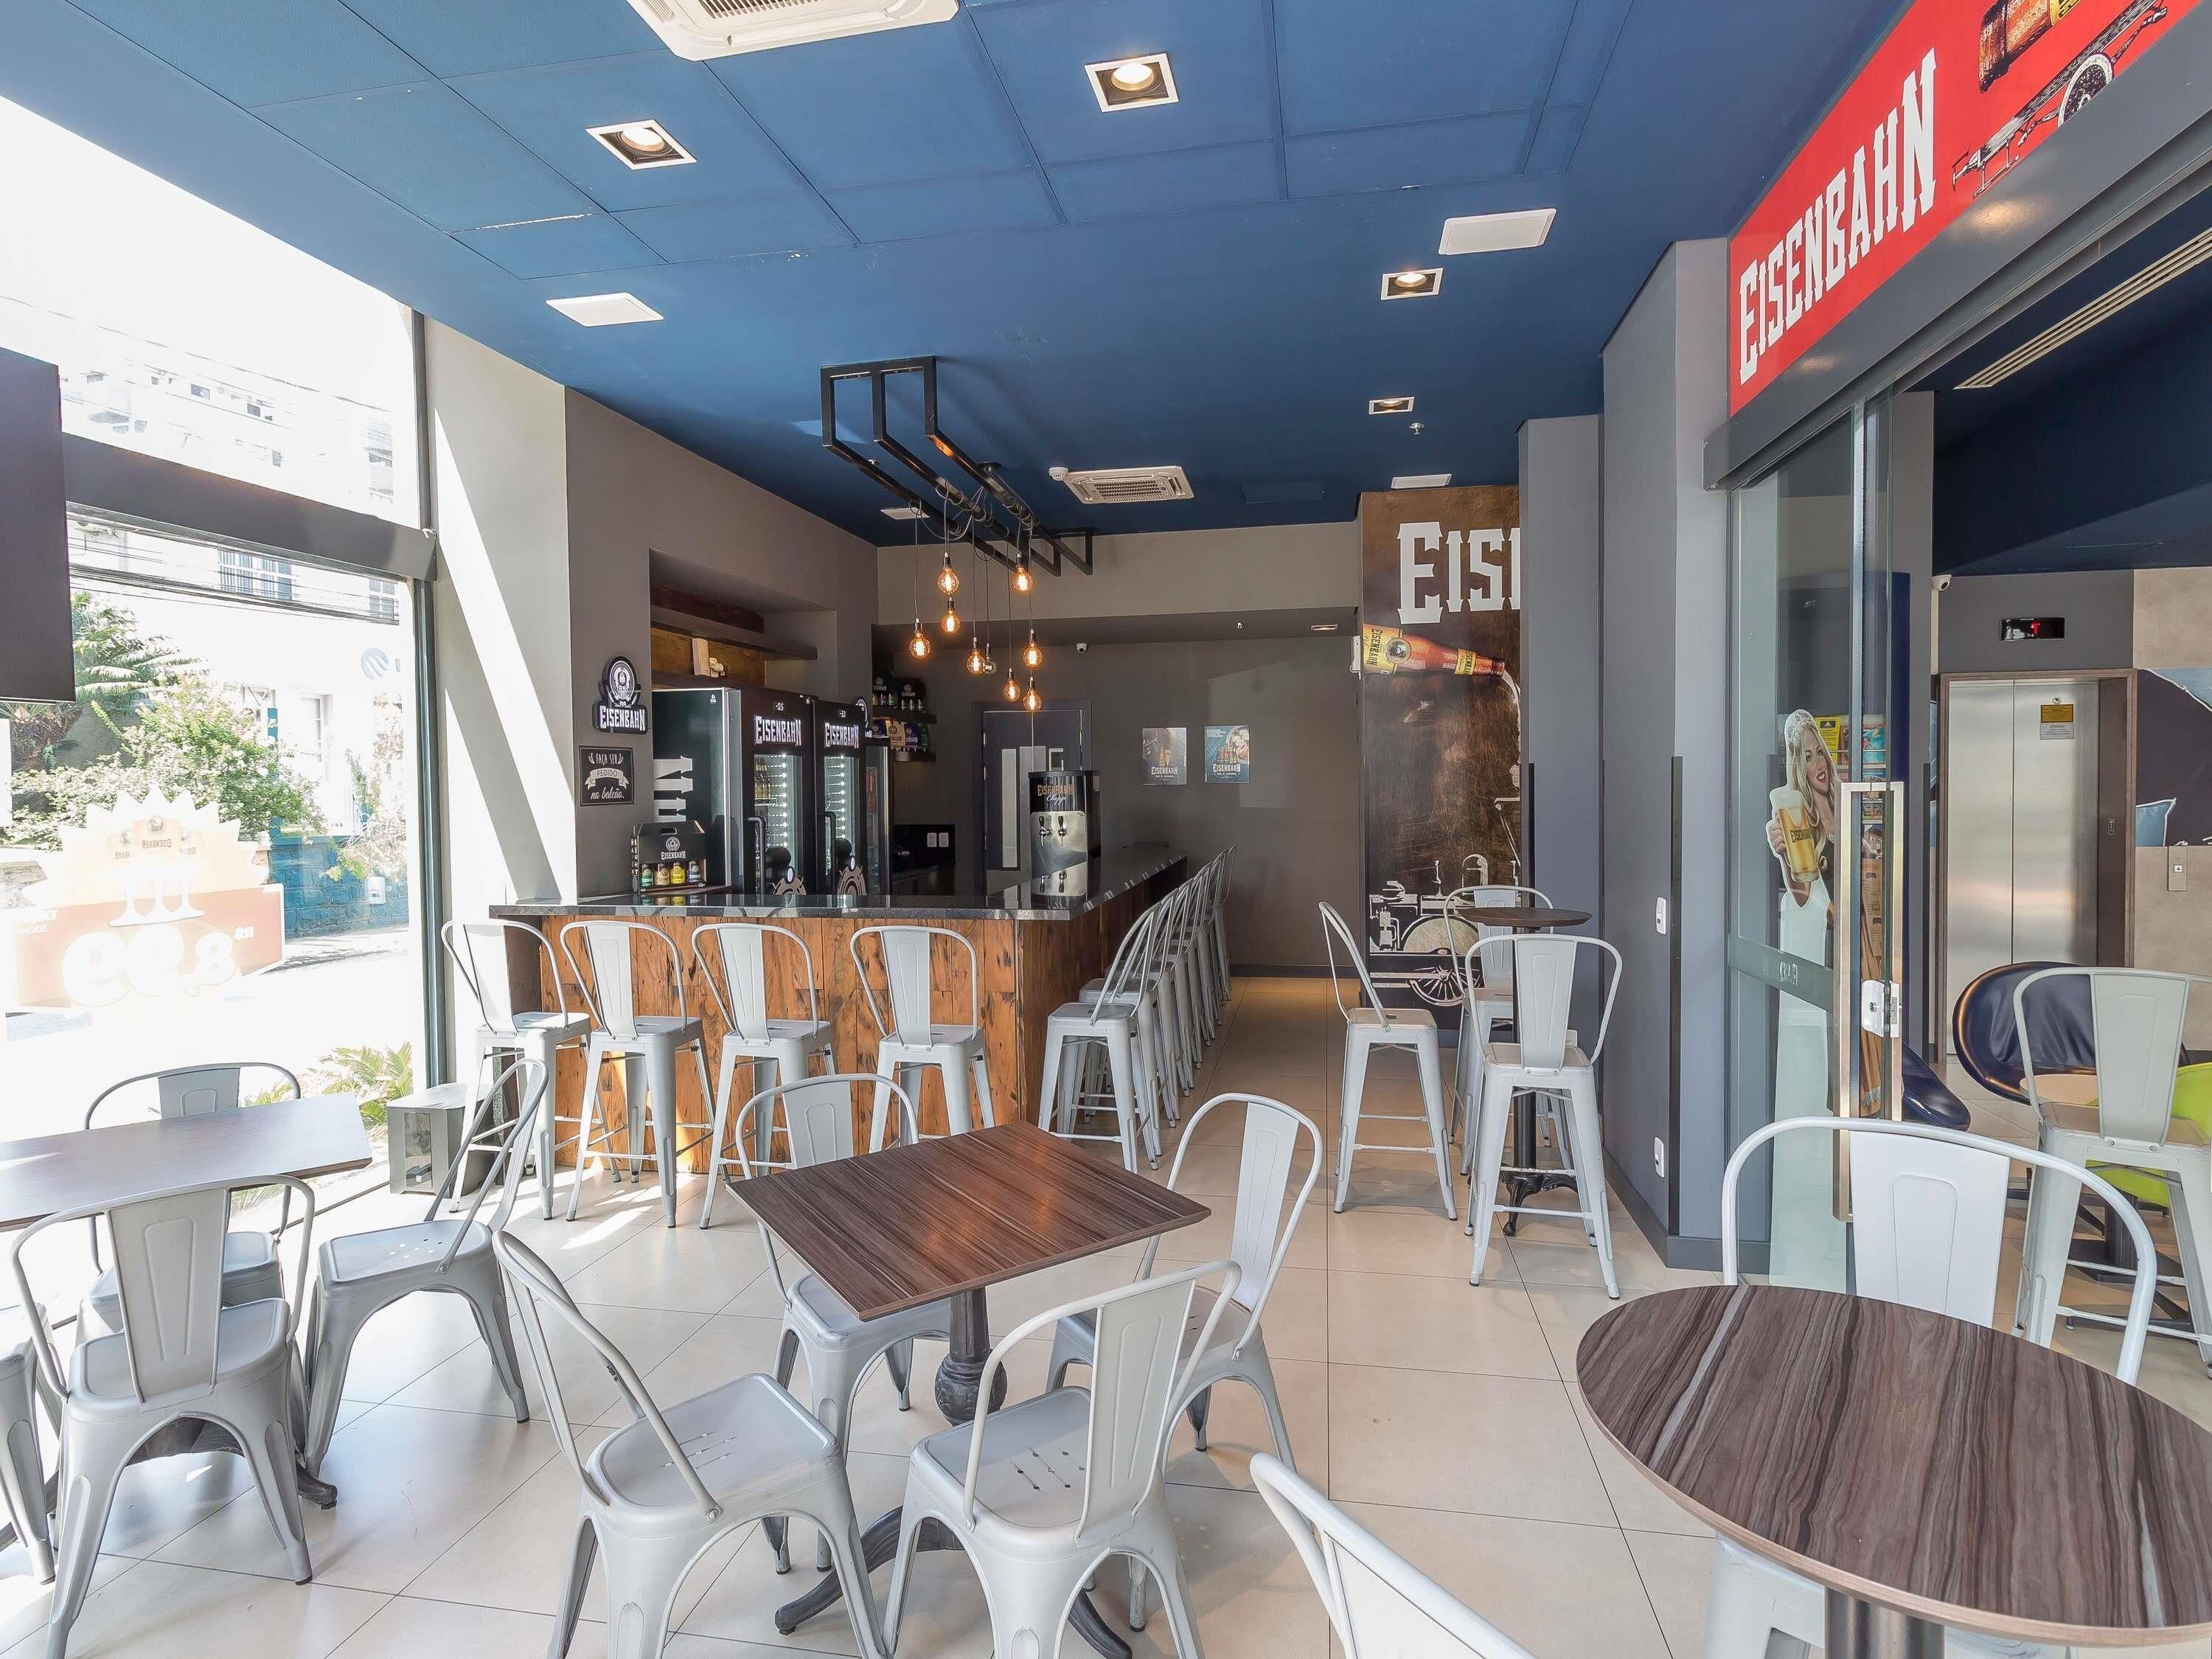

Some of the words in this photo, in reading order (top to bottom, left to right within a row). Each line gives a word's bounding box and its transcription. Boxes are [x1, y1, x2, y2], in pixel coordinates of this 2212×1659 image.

[1739, 46, 1937, 386] EISENBAHN
[1366, 628, 1383, 667] EISENBAHN
[599, 706, 646, 731] EISENBAHN
[754, 715, 802, 746] EISENBAHN
[824, 722, 859, 748] EISENBAHN
[596, 754, 608, 765] FAÇA
[597, 769, 618, 777] PEDIDO
[1037, 784, 1074, 796] EISENBAHN
[661, 850, 686, 860] EISENBAHN
